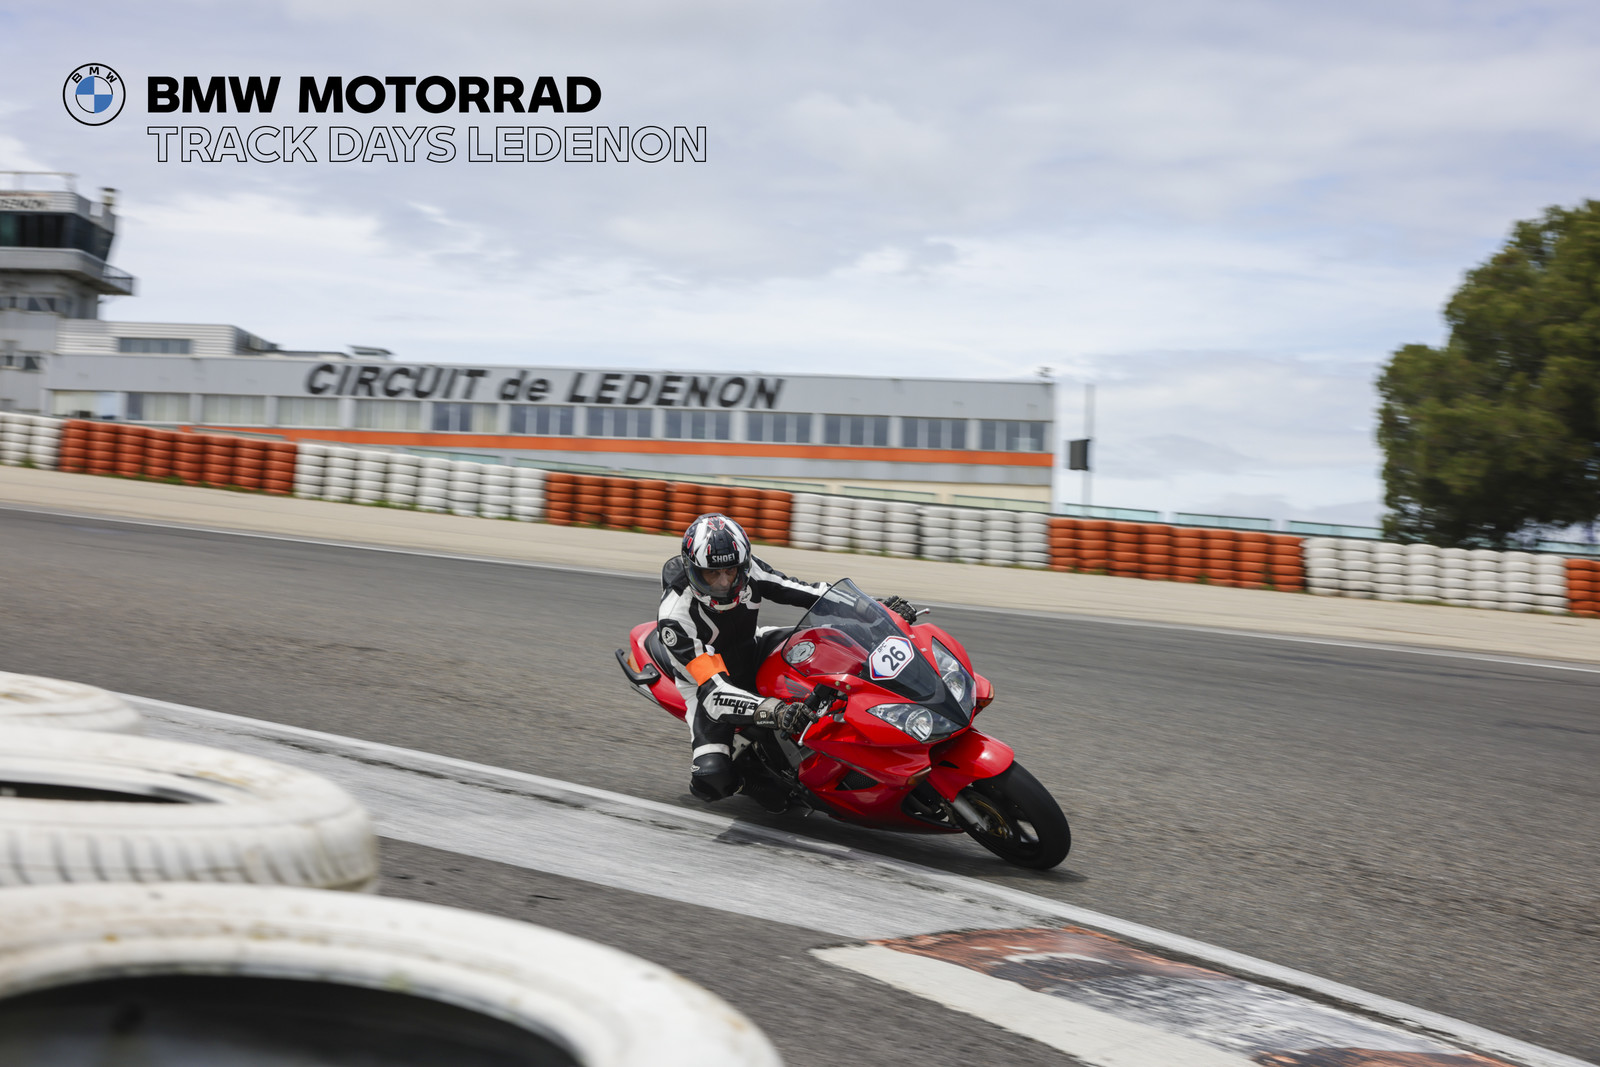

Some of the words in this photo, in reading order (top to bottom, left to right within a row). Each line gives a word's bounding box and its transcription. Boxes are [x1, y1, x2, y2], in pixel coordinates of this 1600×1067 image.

[306, 363, 486, 398] CIRCUIT
[499, 371, 553, 401] de
[567, 373, 785, 409] LEDENON
[711, 553, 736, 563] SHOEI
[881, 646, 907, 672] 26
[712, 691, 759, 715] furyga
